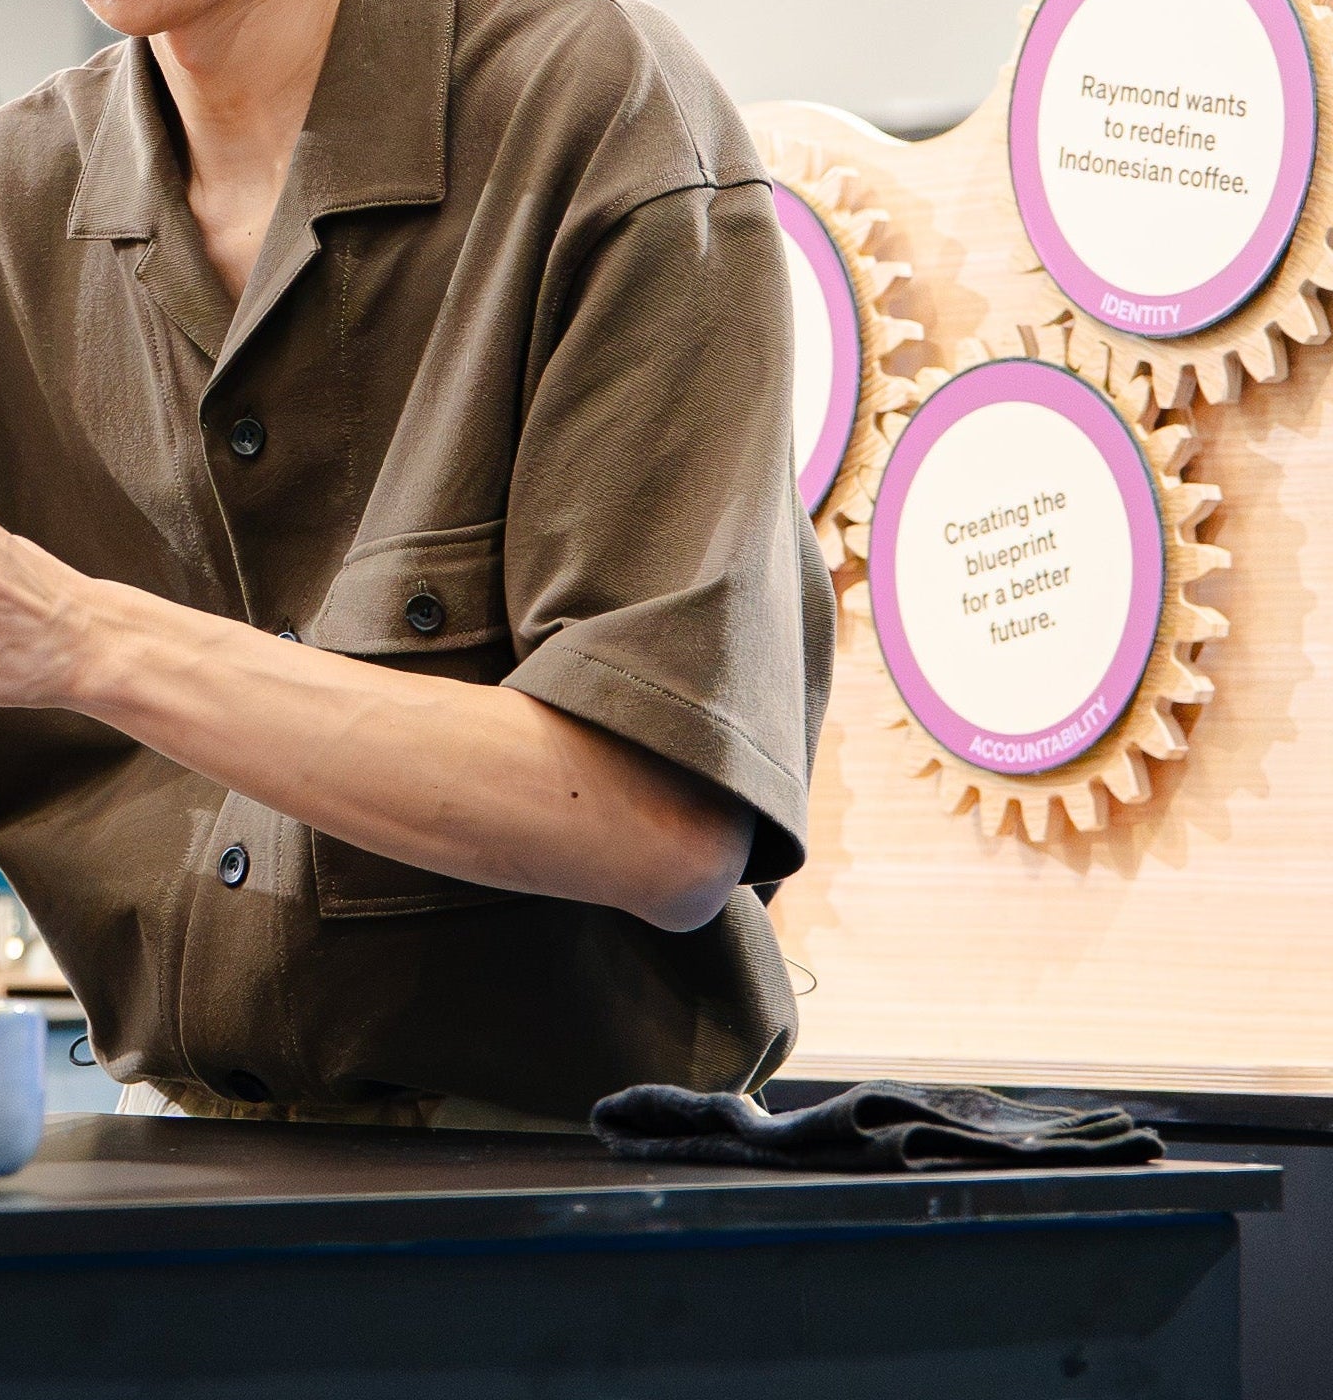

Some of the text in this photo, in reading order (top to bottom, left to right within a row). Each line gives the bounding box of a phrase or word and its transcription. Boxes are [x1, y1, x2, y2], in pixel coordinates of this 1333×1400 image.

[1081, 75, 1247, 118] Raymond wants
[1104, 116, 1216, 152] to redefine
[1058, 146, 1249, 195] Indonesian coffee.
[1100, 292, 1181, 326] IDENTITY
[944, 492, 1067, 545] Creating the
[965, 529, 1057, 576] blueprint
[962, 566, 1071, 616] for a better
[989, 612, 1056, 645] future.
[968, 695, 1108, 763] ACCOUNTABILITY
